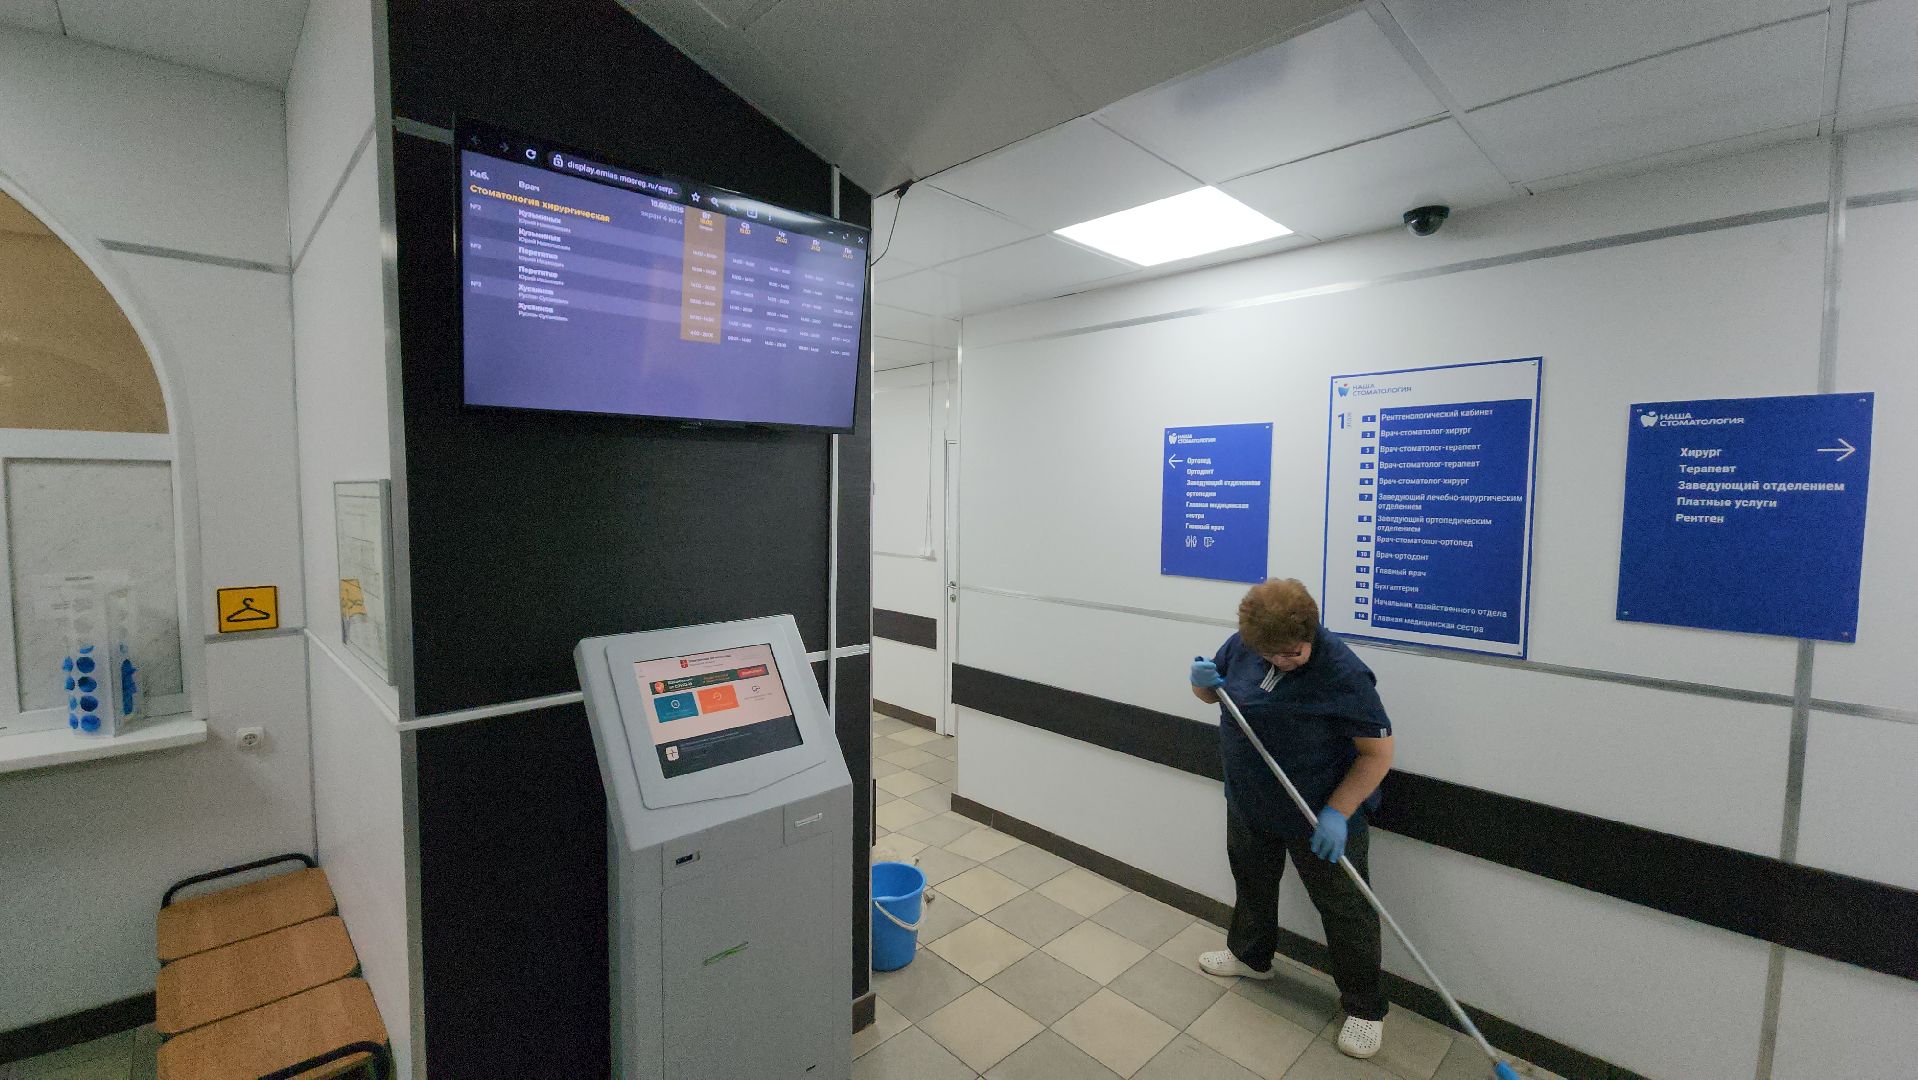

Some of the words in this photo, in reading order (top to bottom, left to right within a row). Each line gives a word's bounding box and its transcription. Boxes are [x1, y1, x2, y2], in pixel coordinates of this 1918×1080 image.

[470, 170, 490, 180] Каб.
[519, 180, 540, 192] Врач
[470, 184, 540, 207] Стоматология
[542, 202, 610, 222] хирургическая
[1352, 386, 1412, 396] СТОМАТОЛОГИЯ
[1381, 410, 1459, 421] Рентгенологический
[1461, 409, 1493, 417] кабинет
[1660, 412, 1692, 420] НАША
[1338, 413, 1344, 429] 1
[1660, 417, 1745, 427] СТОМАТОЛОГИЯ
[1380, 427, 1472, 437] Врач-стоматолог-хирург
[1380, 444, 1482, 454] Врач-стоматолог-терапевт
[1680, 447, 1722, 458] Хирург
[1380, 461, 1480, 469] Врач-стоматолог-терапевт
[1679, 464, 1737, 475] Терапевт
[1379, 478, 1469, 486] Врач-стоматолог-хирург
[1678, 480, 1760, 492] Заведующий
[1763, 482, 1845, 492] отделением
[1378, 493, 1425, 502] Заведующий
[1426, 494, 1523, 503] лечебно-хирургическим
[1676, 497, 1731, 506] Платные
[1734, 500, 1777, 509] услуги
[1378, 515, 1424, 524] Заведующий
[1426, 517, 1492, 525] ортопедическим
[1675, 514, 1724, 523] Рентген
[1376, 536, 1473, 548] Врач-стоматолог-ортопед
[1376, 551, 1429, 560] Врач-ортодонт
[1375, 567, 1407, 575] Главный
[1375, 582, 1419, 593] Бухгалтерия
[1374, 598, 1413, 608] Начальник
[1415, 604, 1476, 614] хозяйственного
[1478, 609, 1507, 618] отдела
[1374, 614, 1403, 623] Главная
[1404, 618, 1455, 629] медицинская
[1457, 623, 1484, 633] сестра
